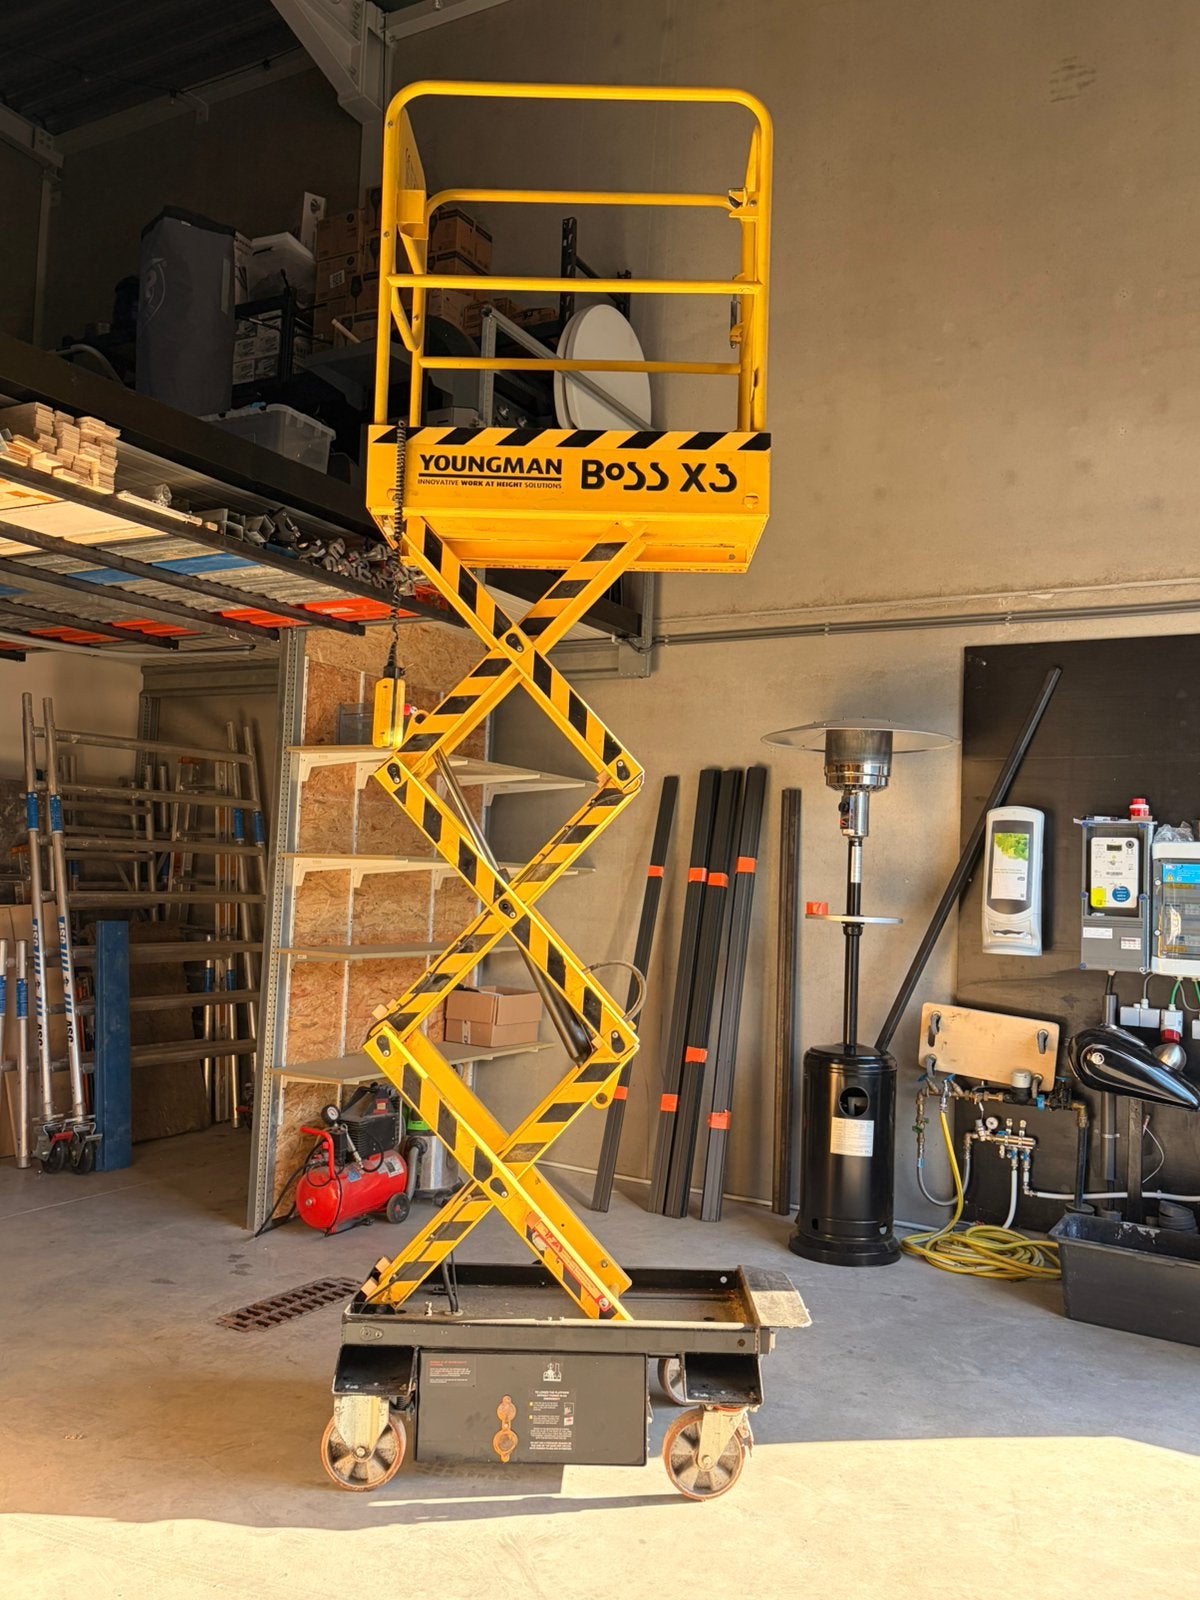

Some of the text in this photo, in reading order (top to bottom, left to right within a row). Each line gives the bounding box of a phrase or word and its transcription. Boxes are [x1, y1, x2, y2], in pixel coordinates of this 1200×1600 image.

[420, 454, 562, 475] YOUNGMAN
[679, 463, 737, 492] X3
[66, 1020, 74, 1043] ASC
